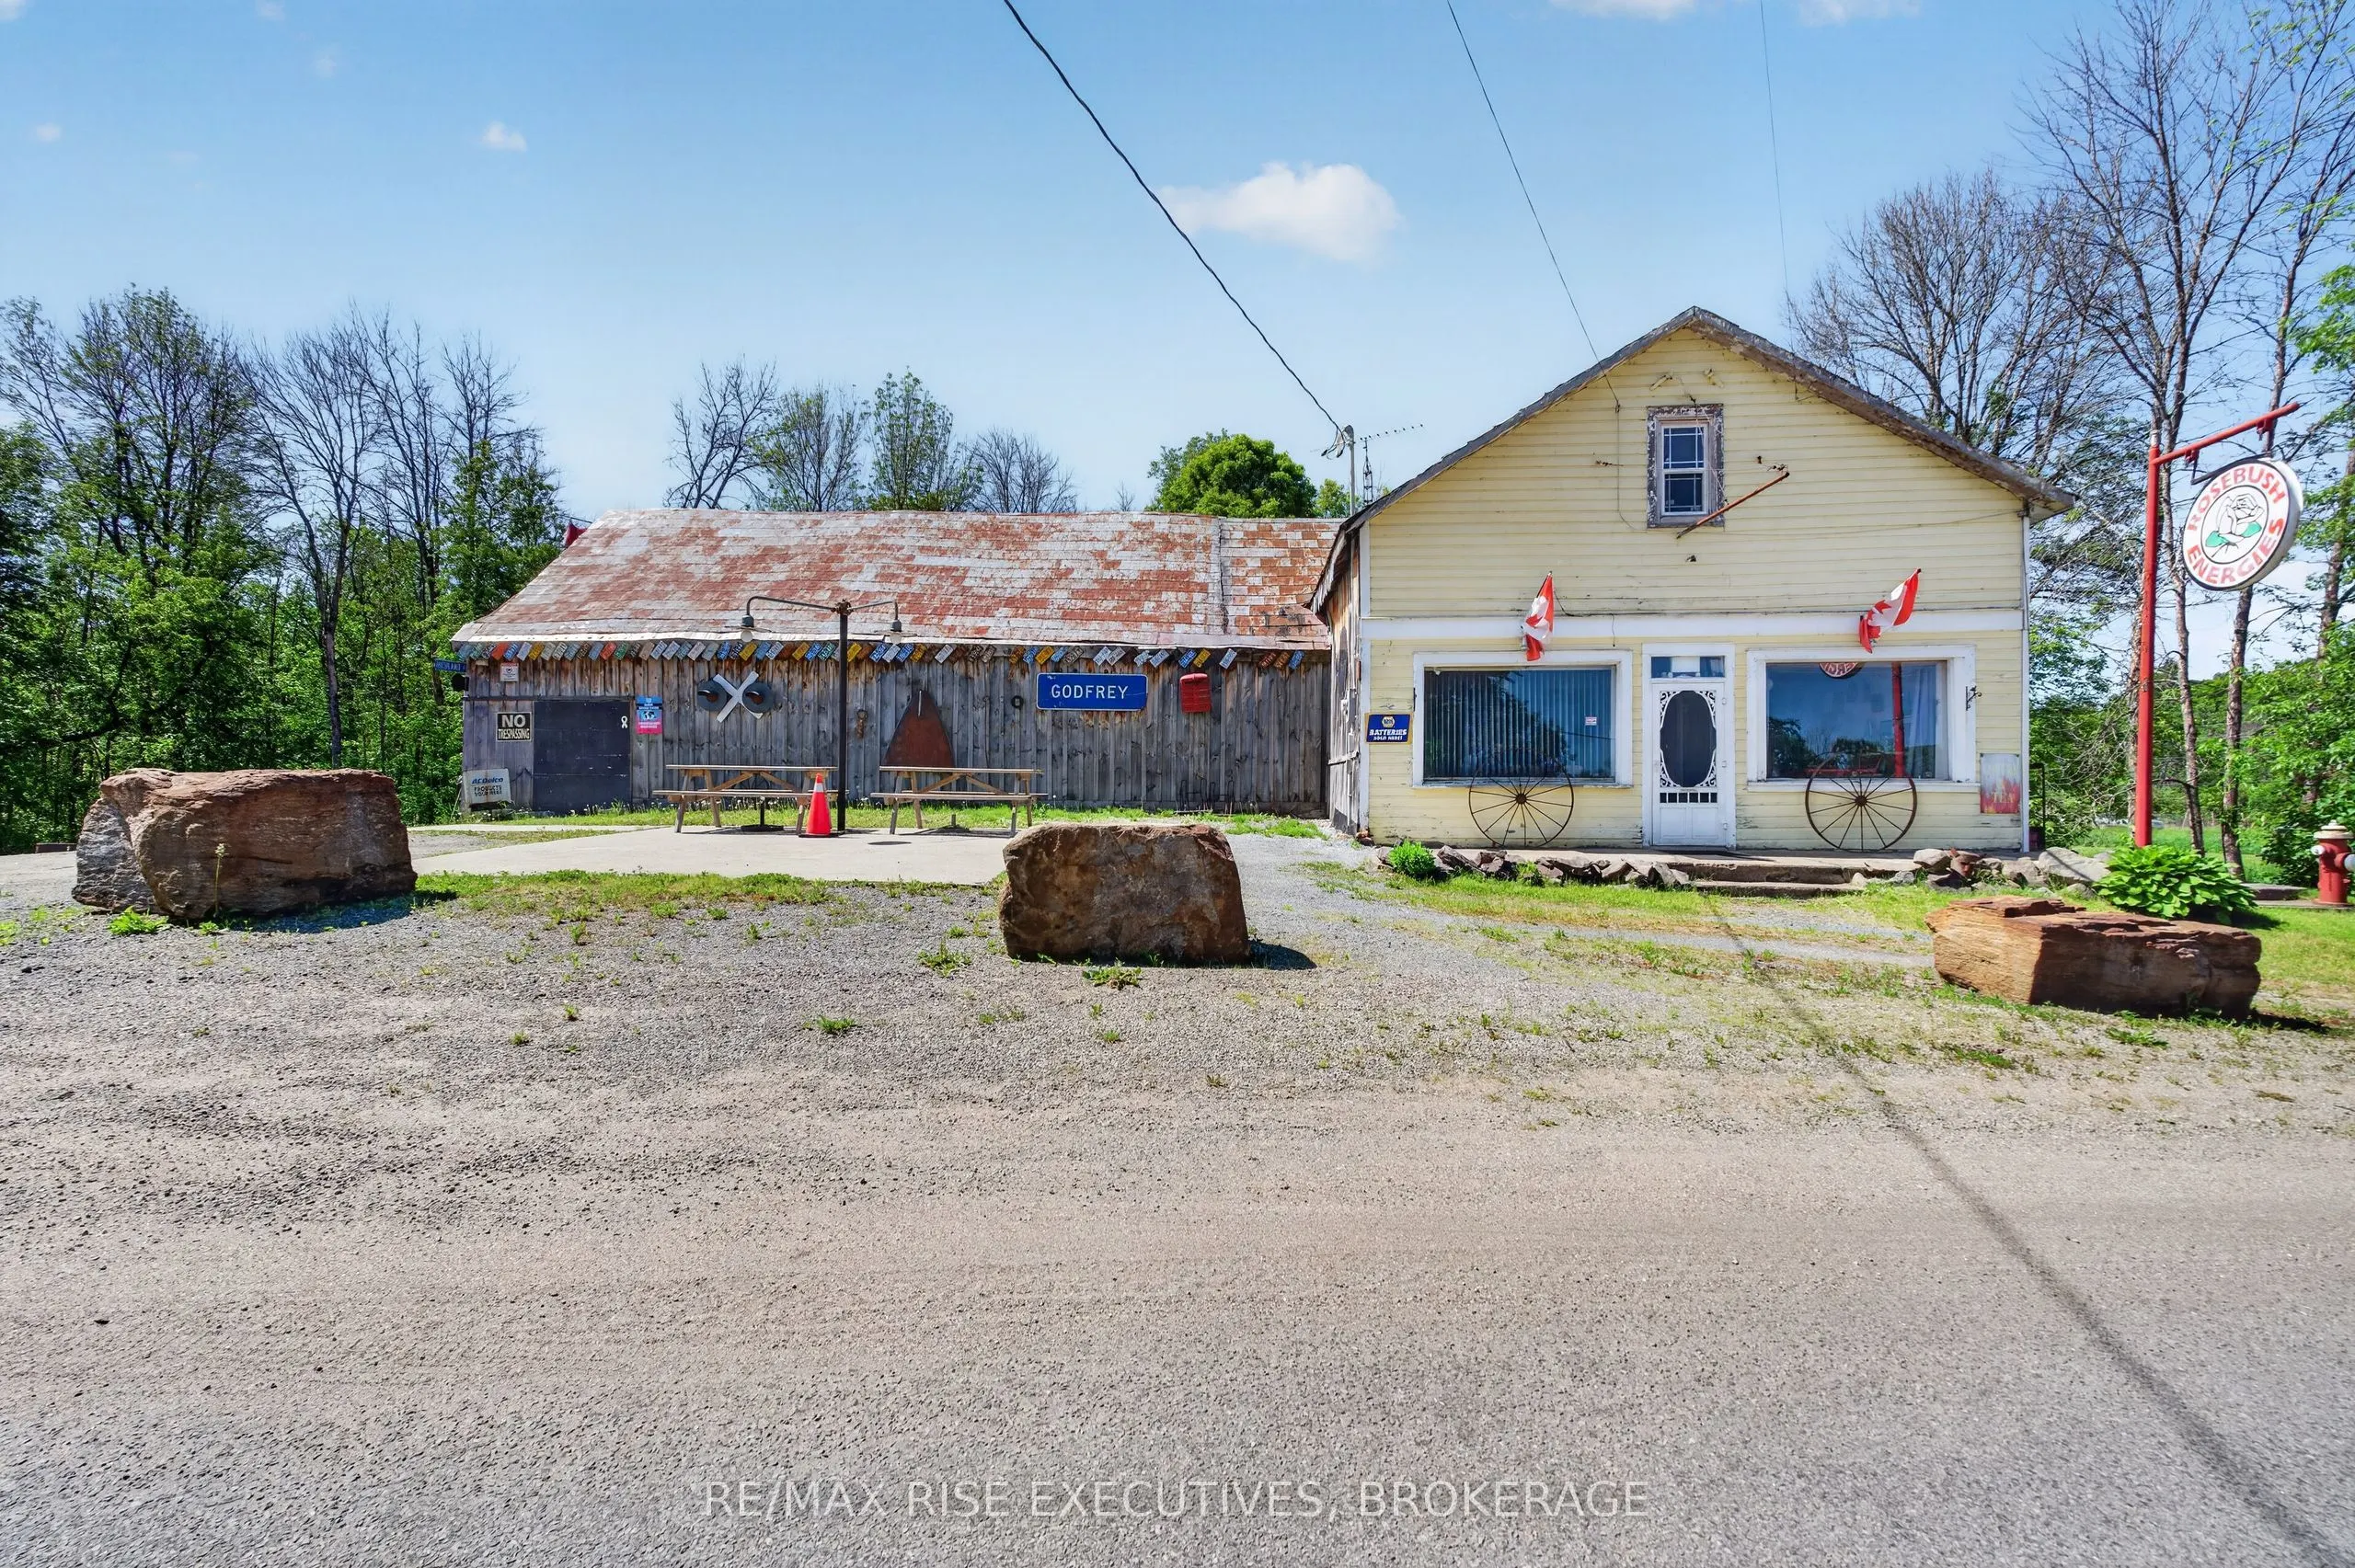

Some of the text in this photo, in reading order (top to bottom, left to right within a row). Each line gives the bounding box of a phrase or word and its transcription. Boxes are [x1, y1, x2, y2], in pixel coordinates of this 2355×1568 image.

[2187, 465, 2286, 532] ROSEBUSH
[2186, 518, 2285, 585] ENERGIES
[1051, 684, 1129, 699] GODFREY
[501, 714, 526, 727] NO
[498, 727, 530, 739] TRESPASSING
